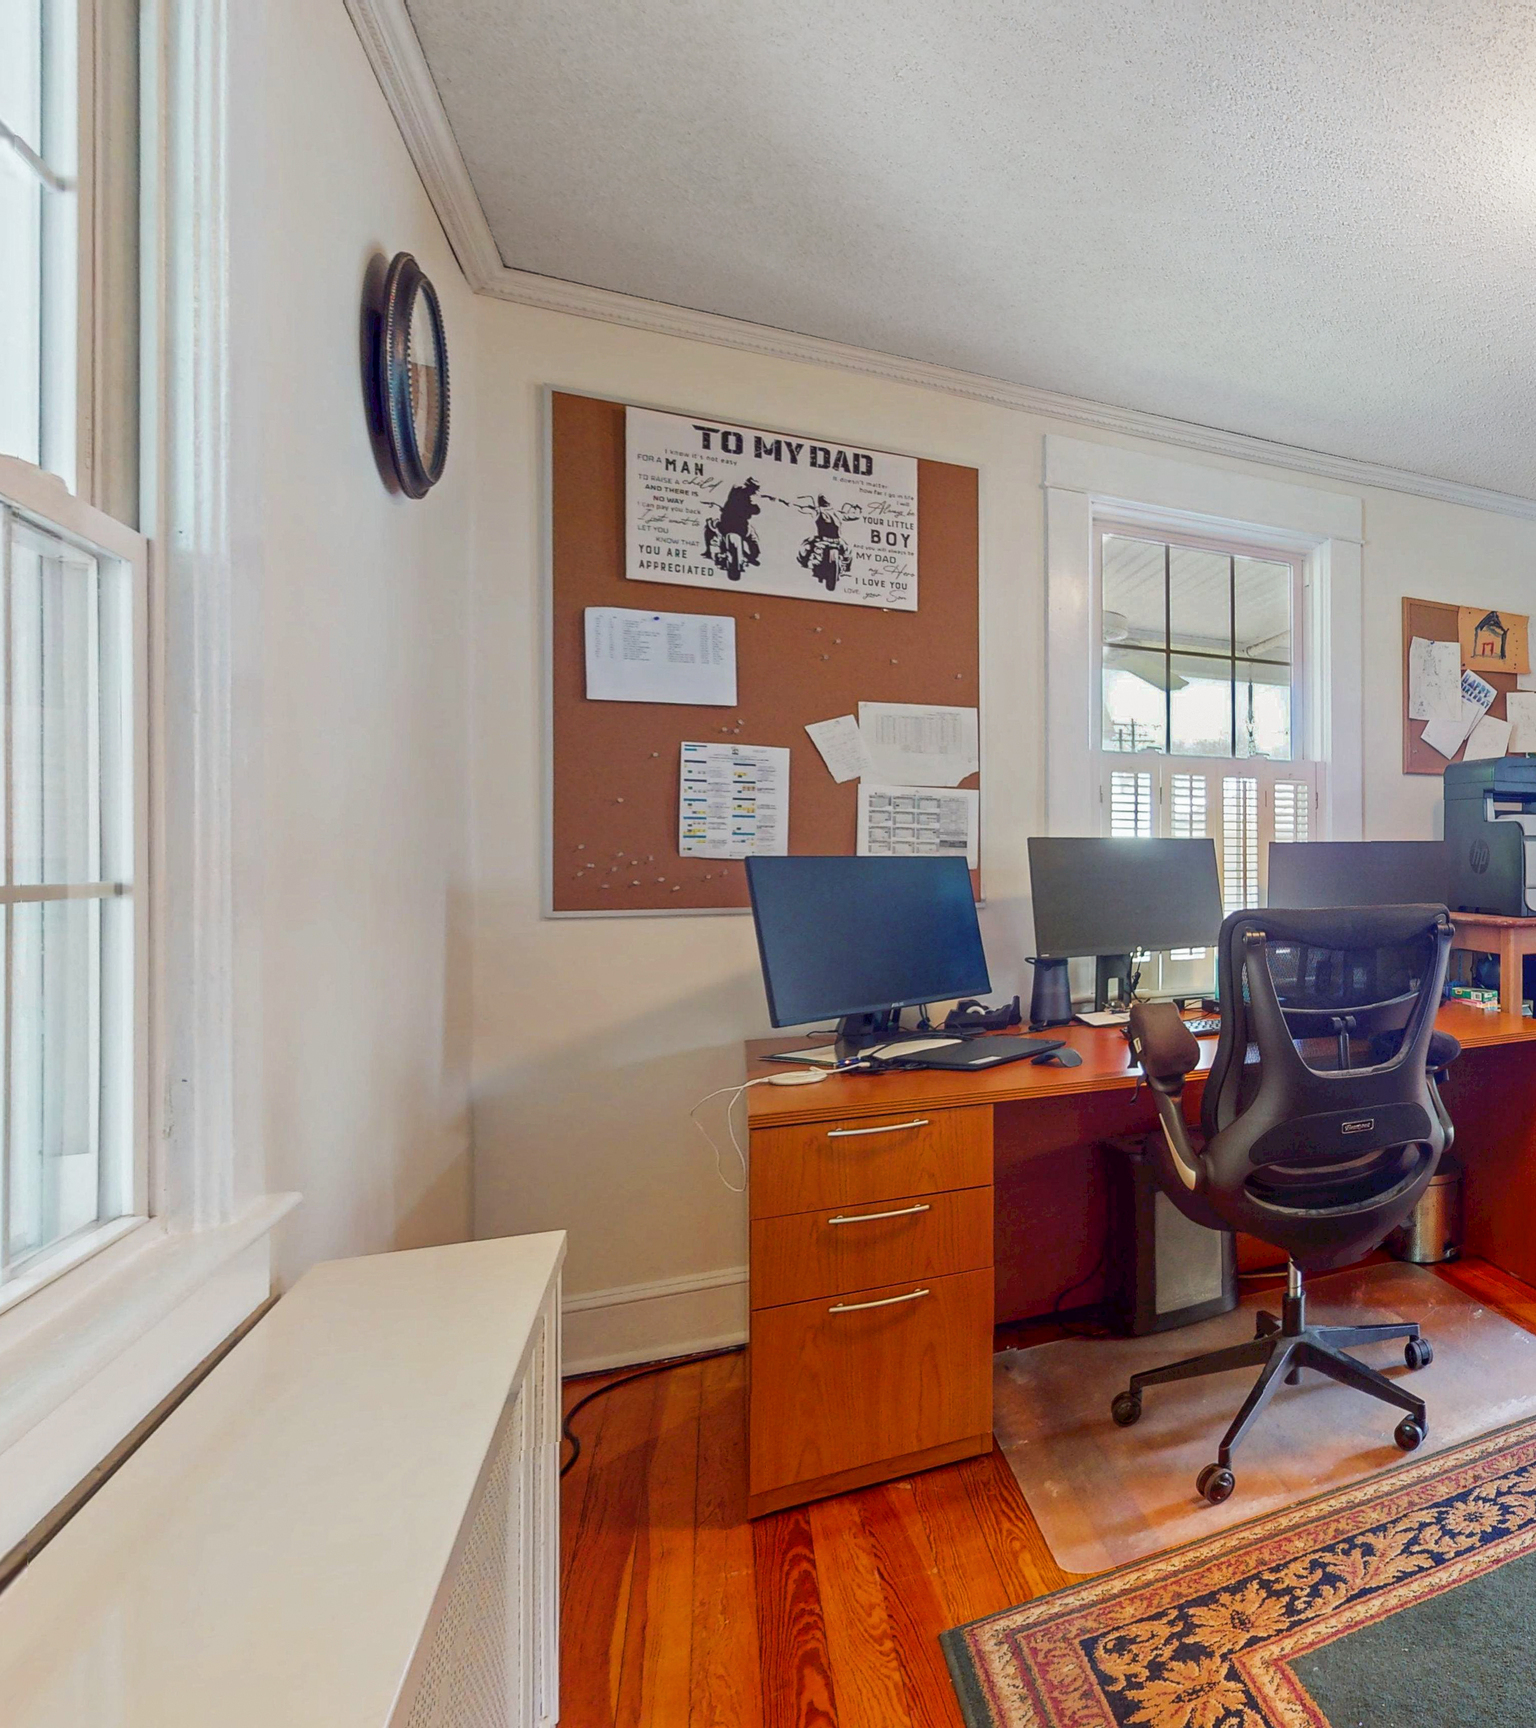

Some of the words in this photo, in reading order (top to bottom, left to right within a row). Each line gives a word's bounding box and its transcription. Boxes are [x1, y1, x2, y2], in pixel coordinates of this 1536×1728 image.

[692, 424, 743, 455] TO
[754, 435, 804, 465] MY
[809, 445, 873, 476] DAD
[637, 453, 654, 462] FOR
[664, 457, 704, 477] MAN
[669, 449, 690, 458] know
[691, 452, 704, 460] it's
[706, 455, 718, 463] not
[721, 458, 738, 467] easy
[638, 473, 649, 481] TO
[650, 475, 672, 485] RAISE
[682, 476, 723, 493] child
[645, 484, 662, 492] AND
[664, 486, 690, 496] THERE
[666, 497, 685, 505] WAY
[653, 526, 669, 534] YOU
[863, 516, 884, 526] YOUR
[887, 519, 914, 530] LITTLE
[656, 537, 680, 545] KNOW
[681, 539, 699, 547] THAT
[871, 529, 910, 549] BOY
[639, 544, 660, 556] YOU
[667, 547, 687, 559] ARE
[856, 552, 872, 561] MY
[874, 554, 897, 565] DAD
[639, 559, 714, 577] APPRECIATED
[862, 578, 886, 588] LOVE
[889, 581, 908, 590] YOU
